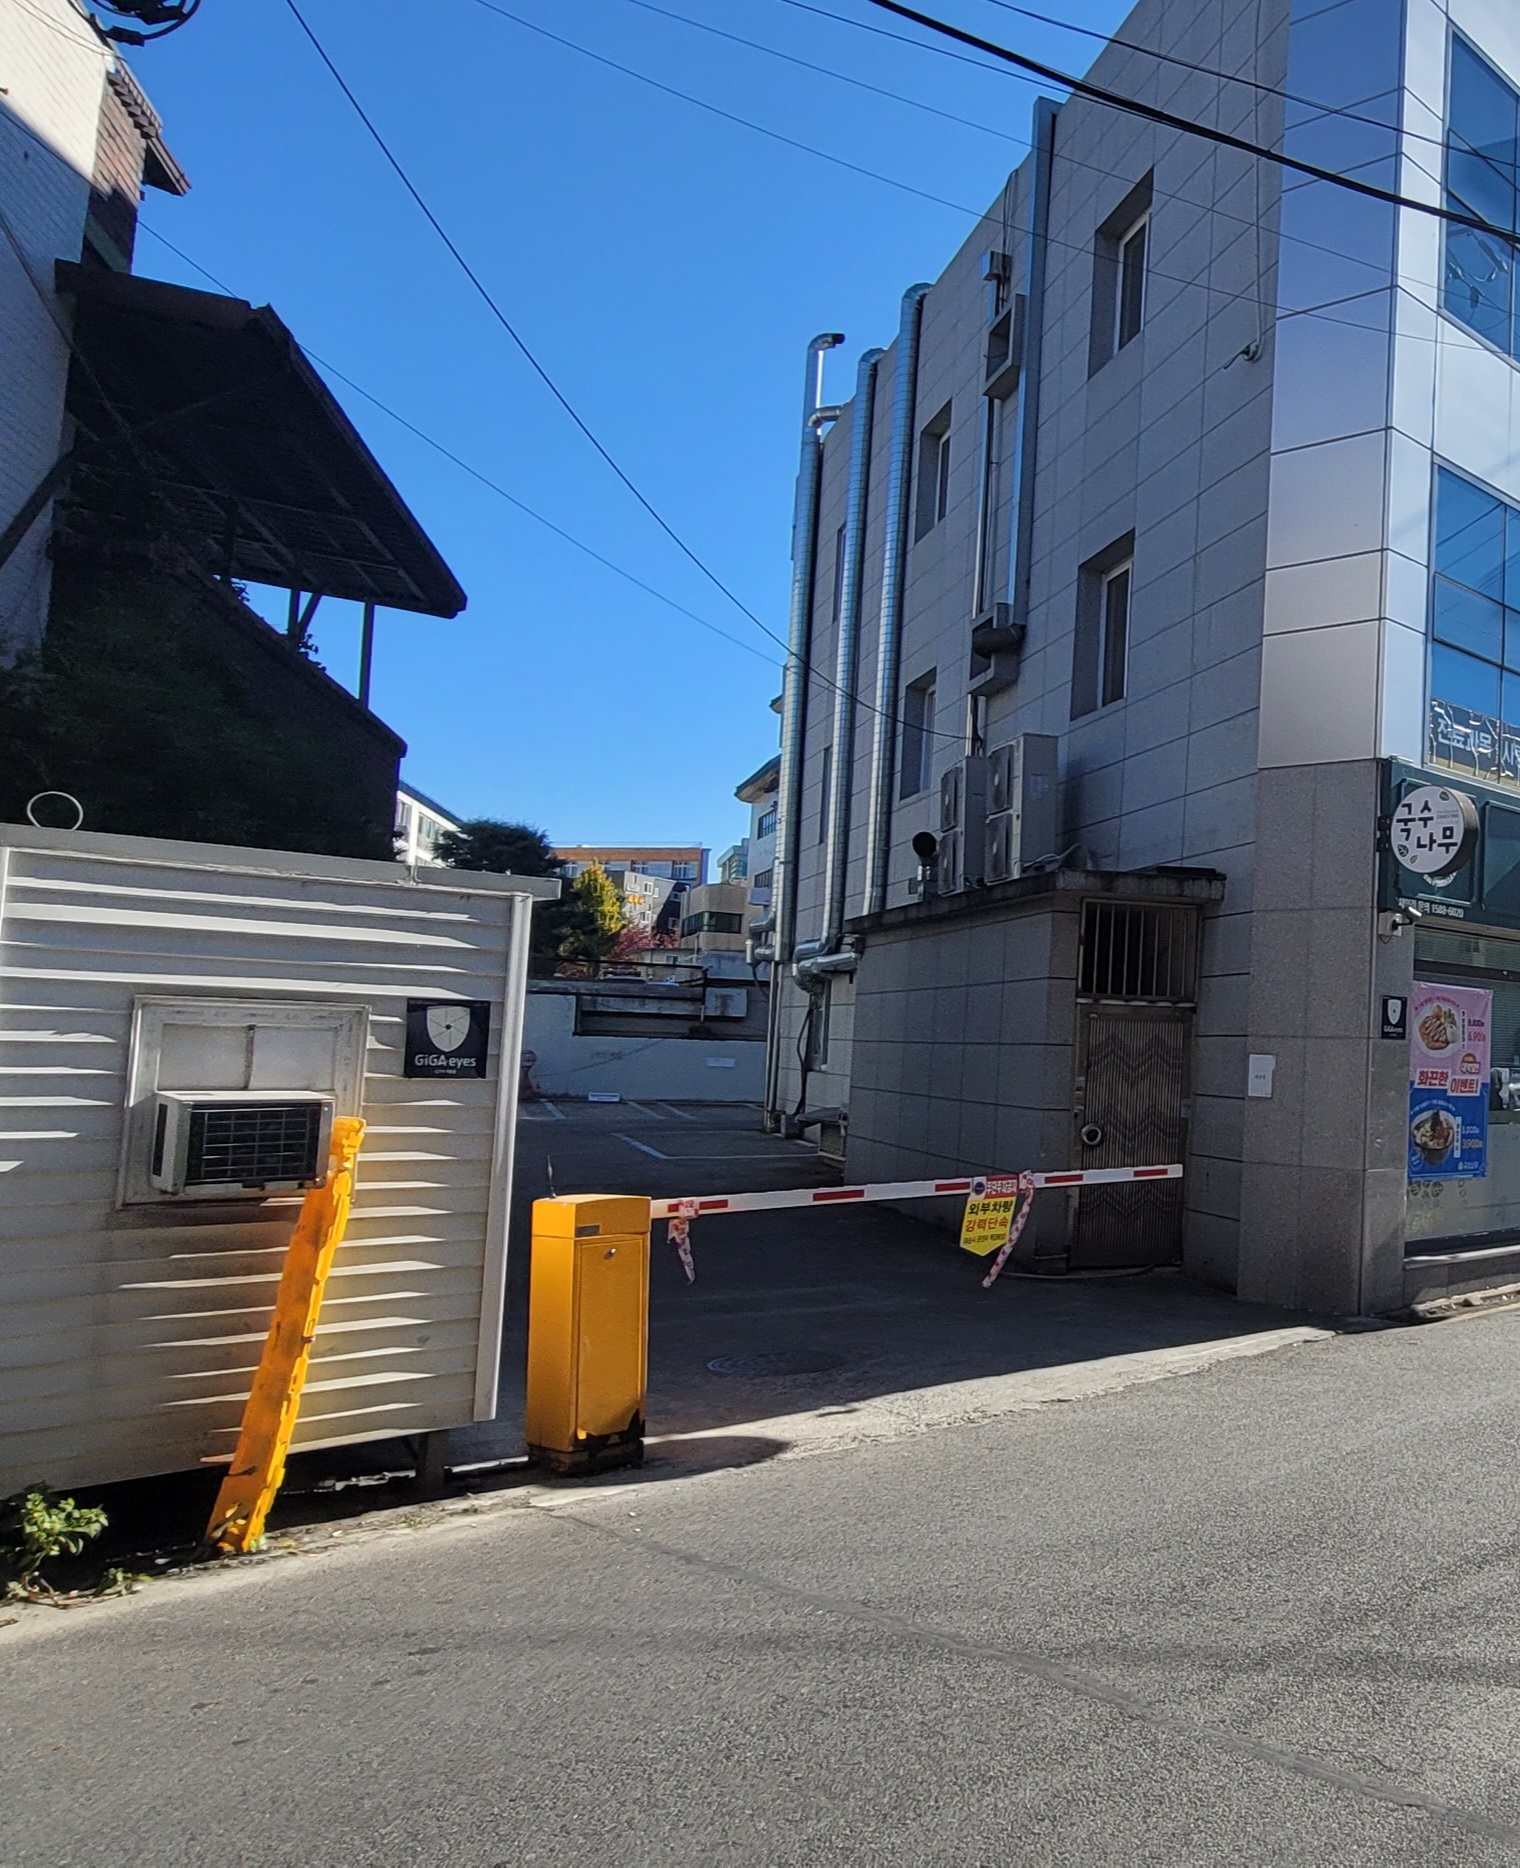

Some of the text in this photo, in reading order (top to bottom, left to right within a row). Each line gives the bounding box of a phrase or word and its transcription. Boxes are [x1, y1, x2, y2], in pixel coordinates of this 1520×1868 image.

[1417, 1069, 1449, 1087] 화끈한
[967, 1200, 1013, 1216] 외부차량
[965, 1216, 1009, 1233] 강력단속
